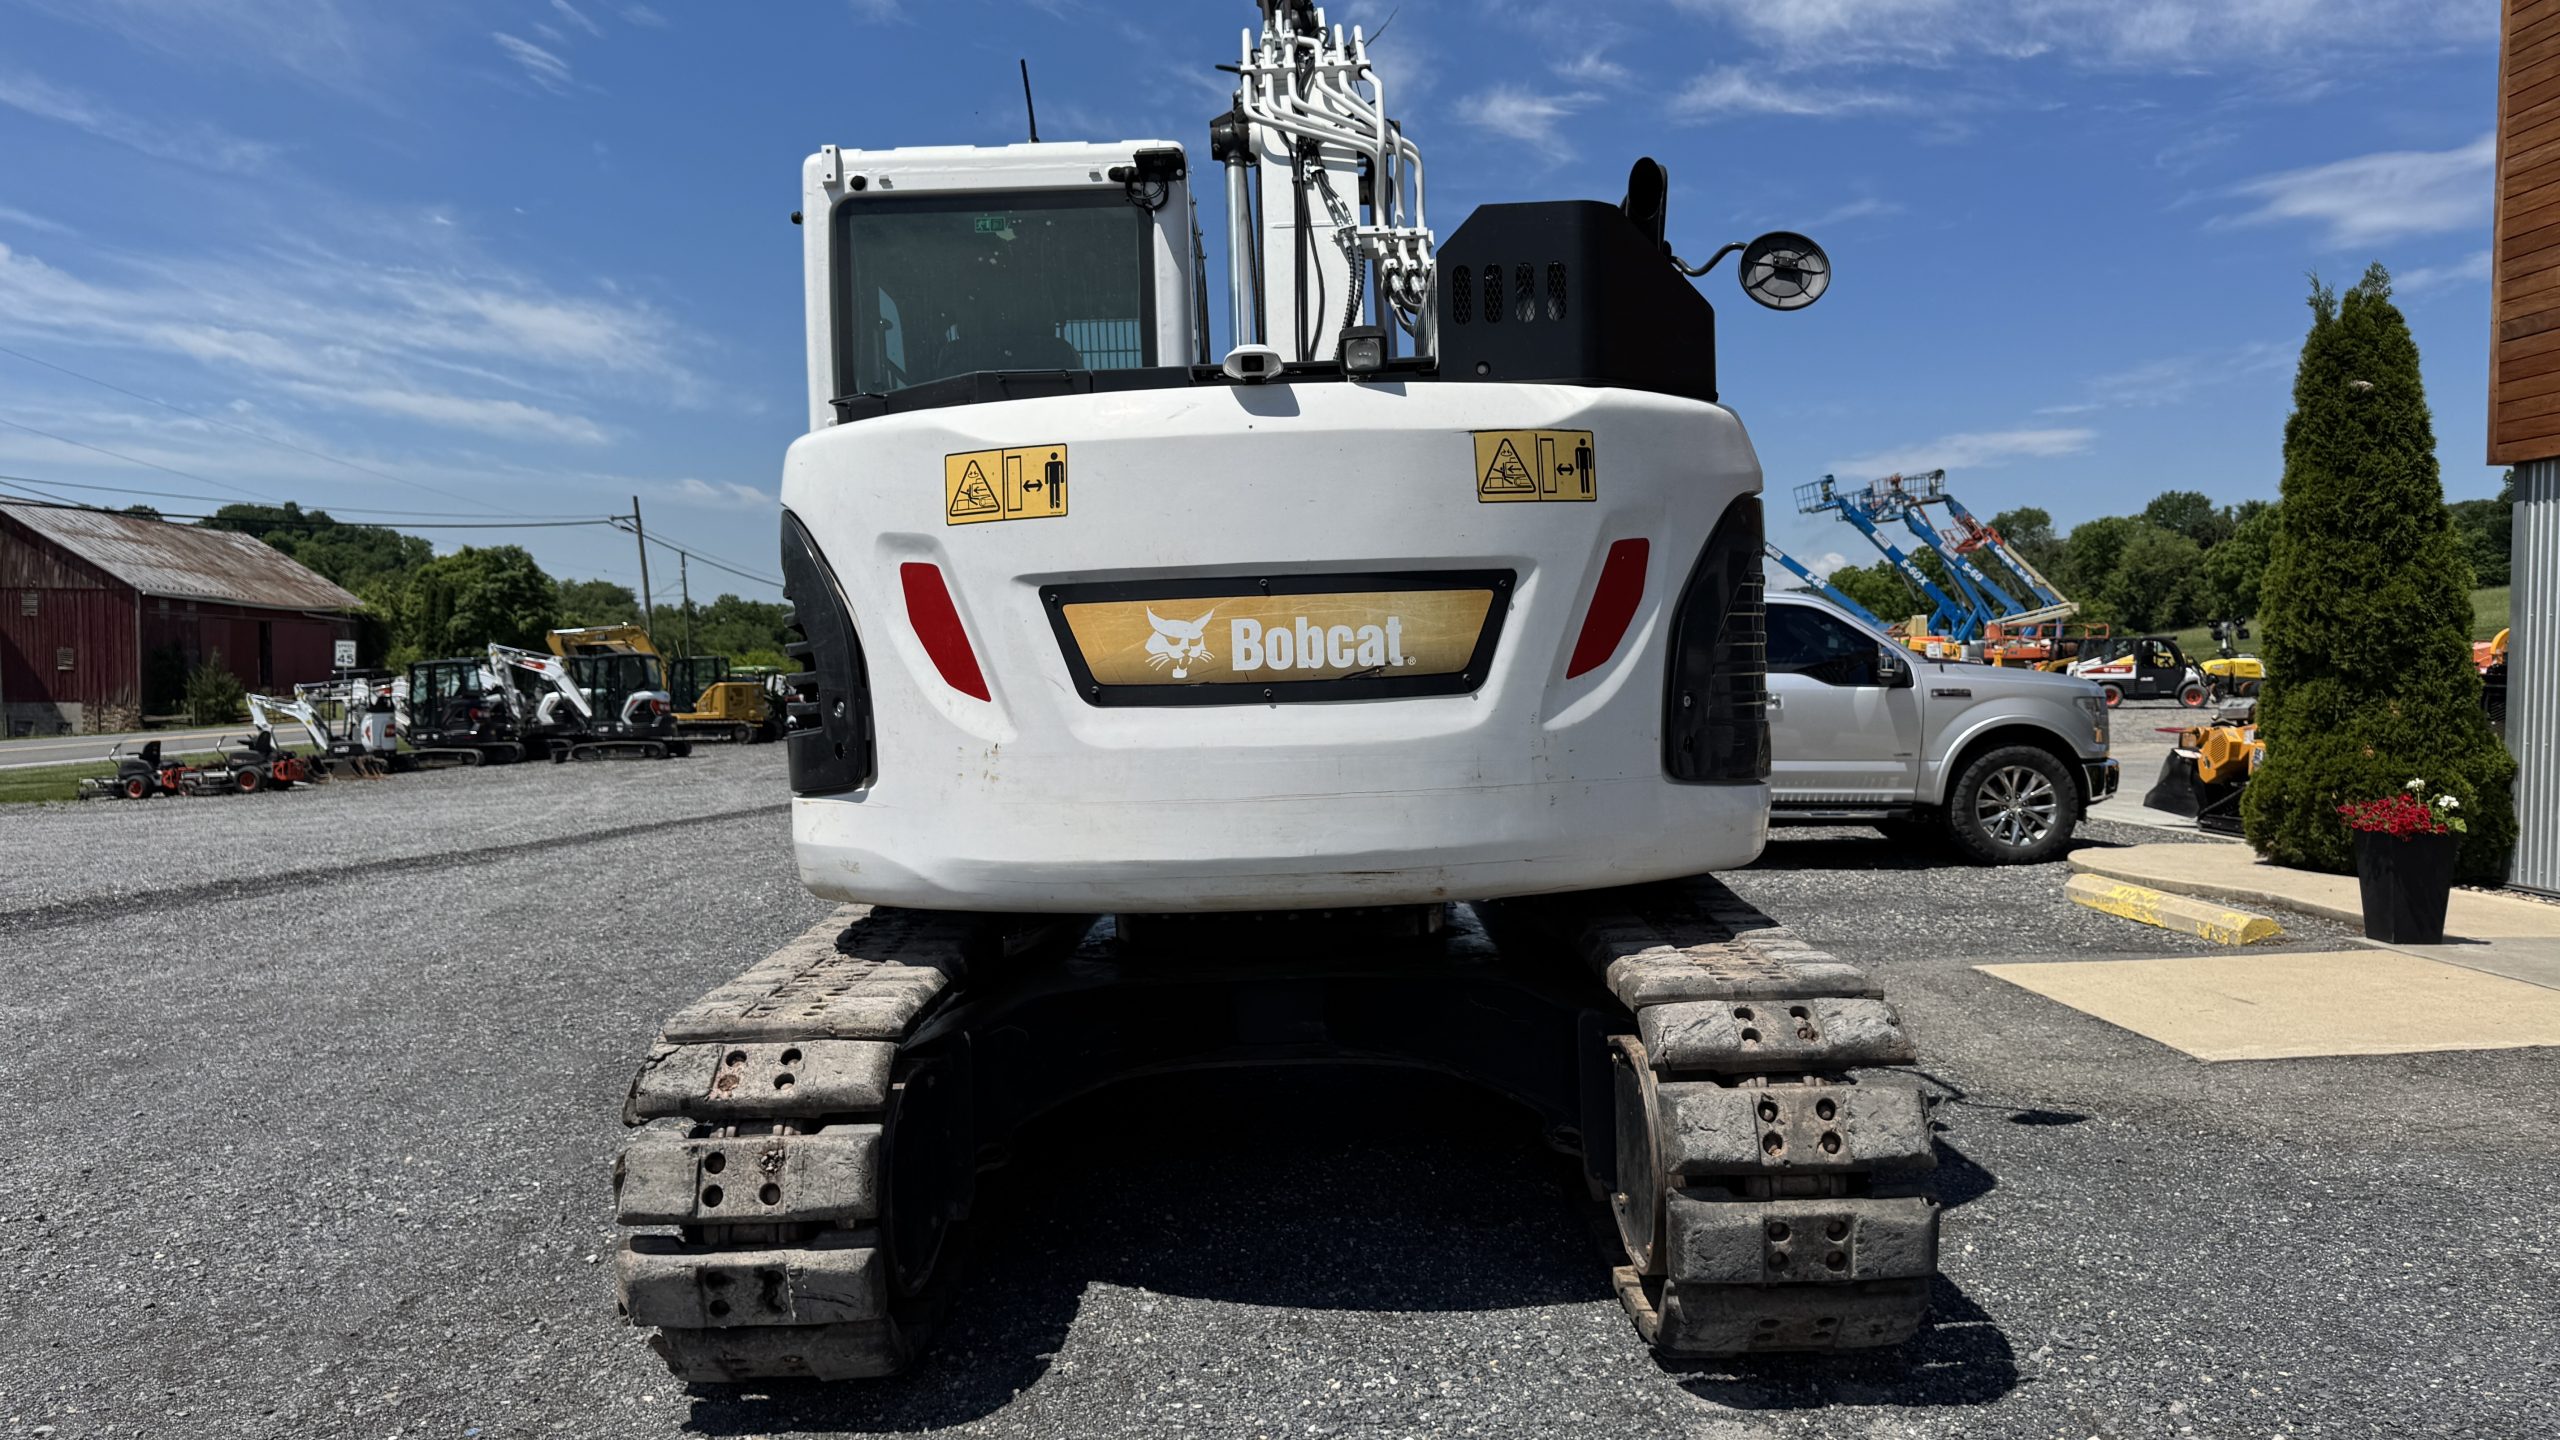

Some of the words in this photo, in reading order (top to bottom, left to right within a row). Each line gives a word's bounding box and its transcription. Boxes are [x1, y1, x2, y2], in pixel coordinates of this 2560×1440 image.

[1804, 572, 1827, 590] S-65
[1900, 558, 1930, 587] S-60X
[1961, 561, 1984, 582] S-60
[1231, 616, 1404, 671] Bobcat
[337, 654, 354, 664] 45
